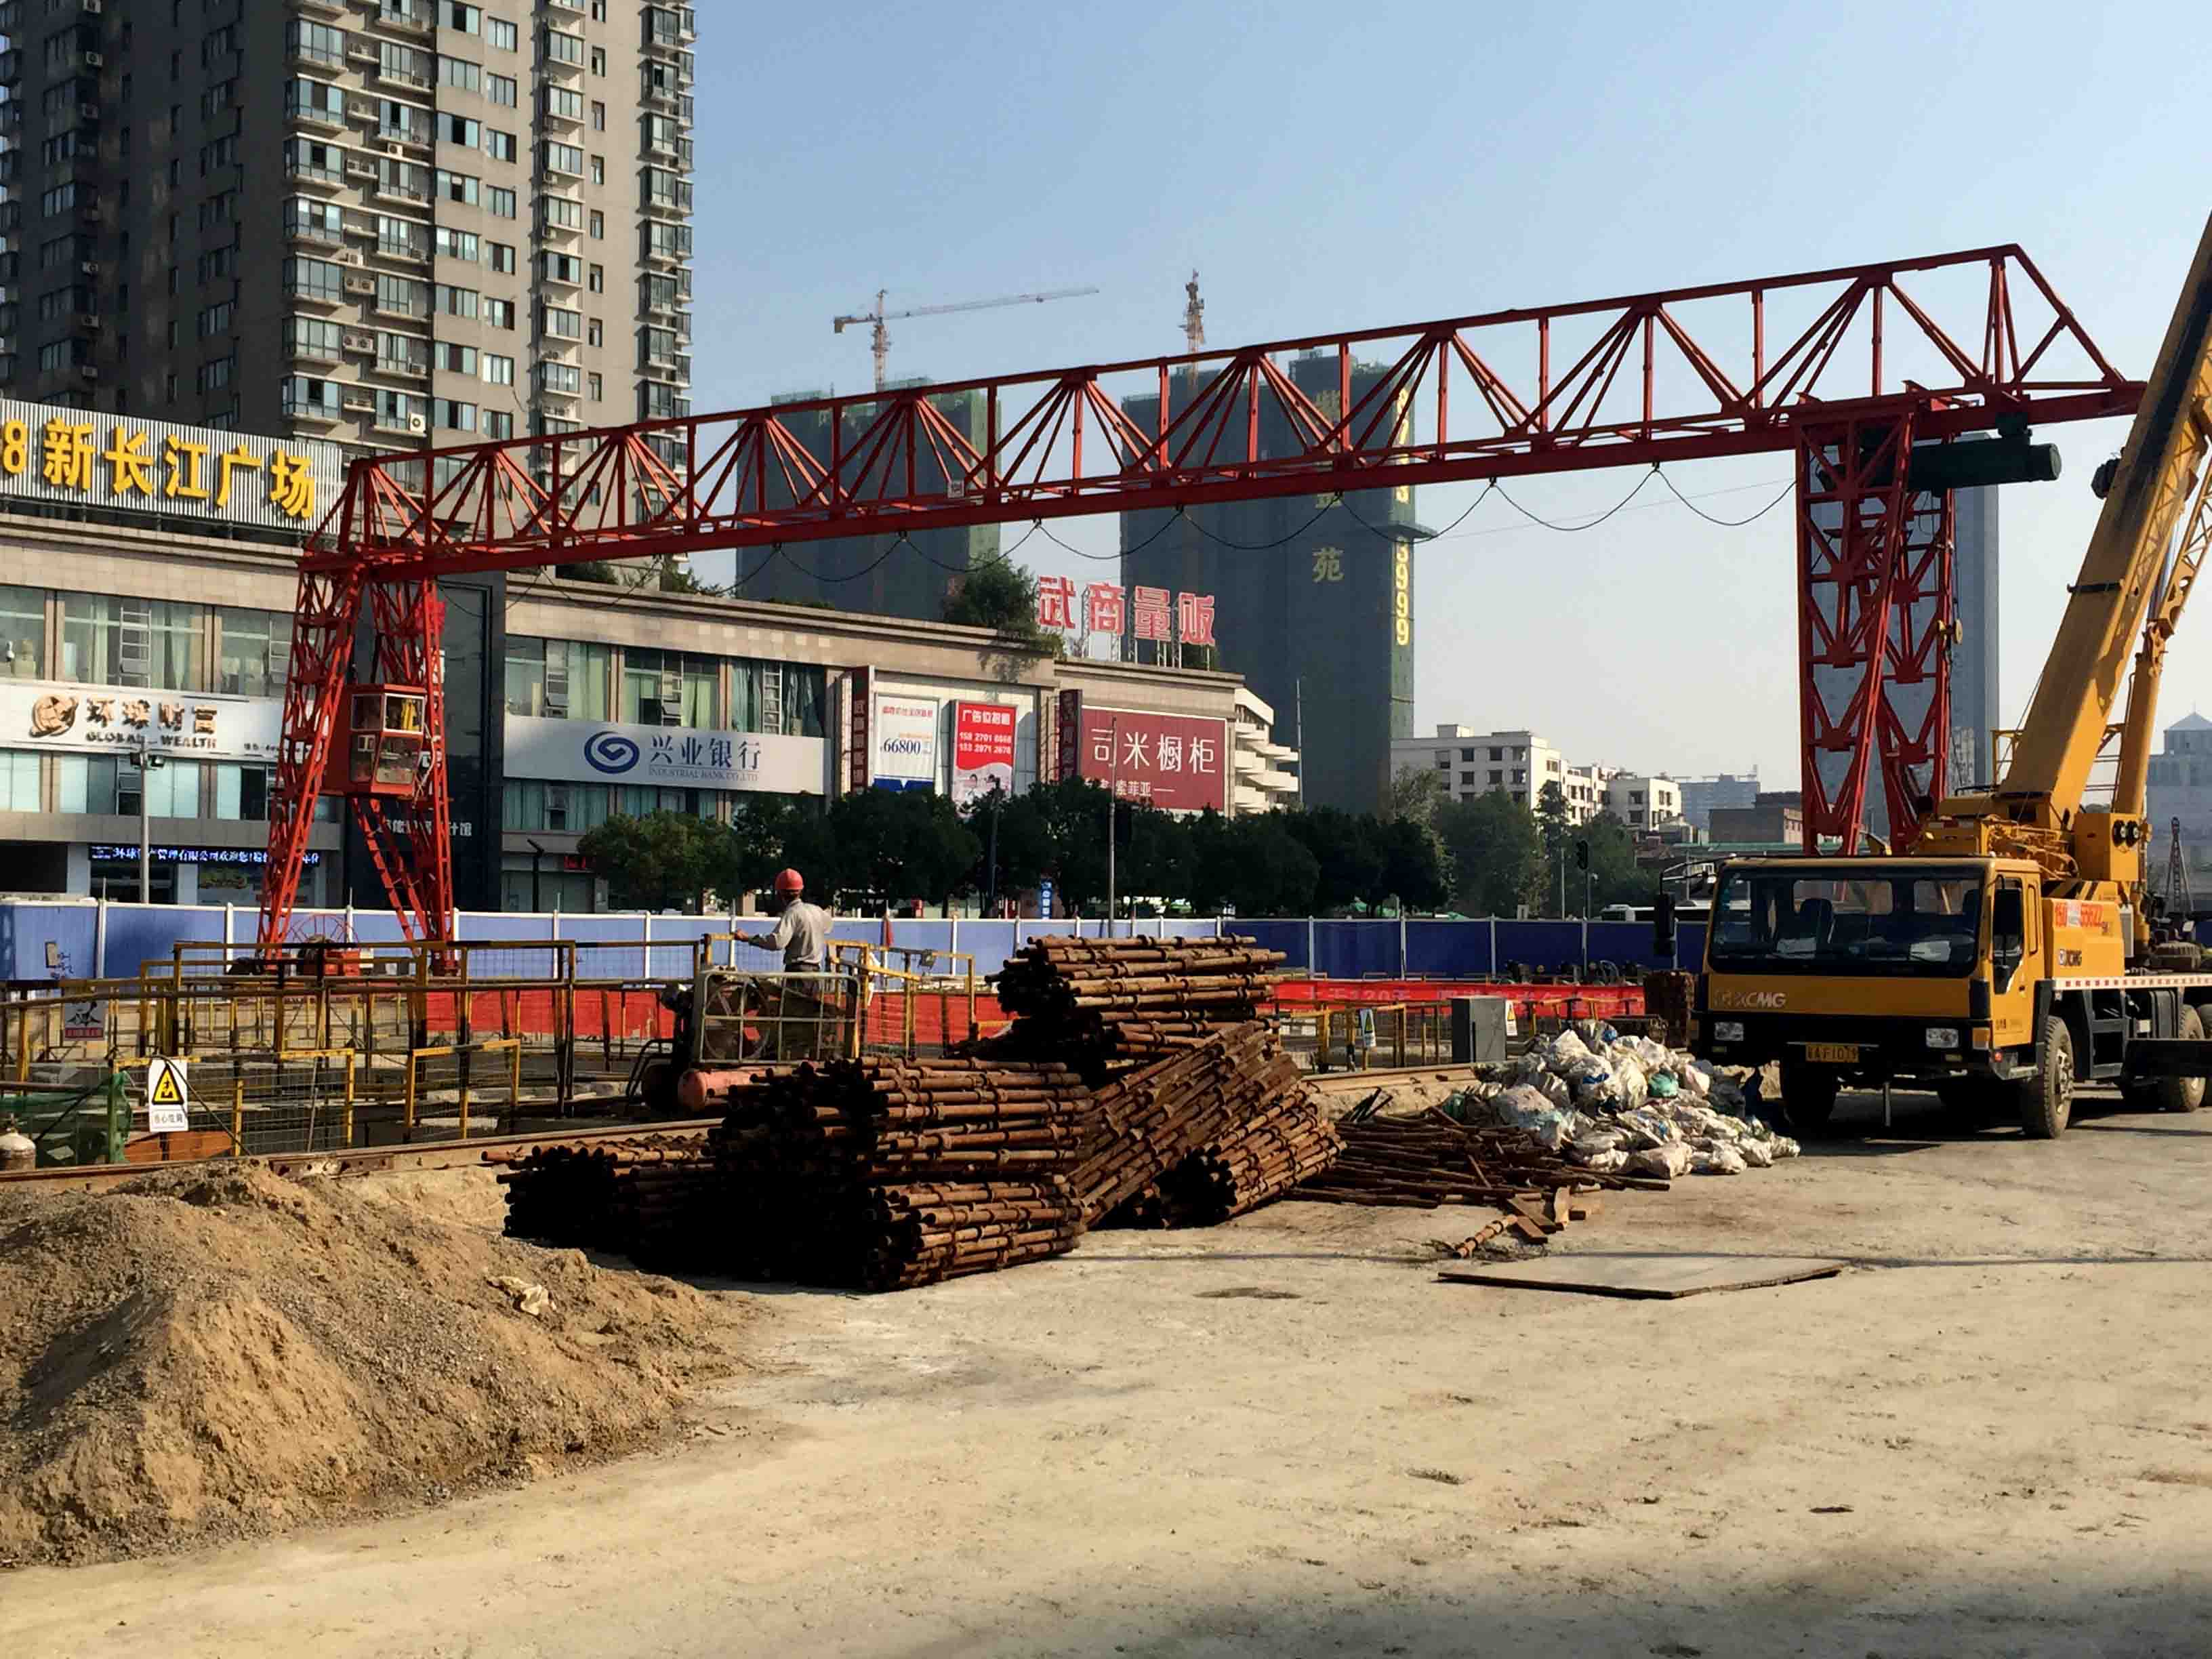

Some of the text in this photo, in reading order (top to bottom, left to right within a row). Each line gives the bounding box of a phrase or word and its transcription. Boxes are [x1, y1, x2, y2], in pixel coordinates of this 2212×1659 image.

[1038, 575, 1215, 646] 武商量贩
[160, 735, 217, 750] WEALTH
[650, 735, 762, 770] 兴业银行
[883, 737, 921, 756] 66800
[1091, 728, 1216, 775] 司米橱柜
[1734, 991, 1788, 1009] XCMG
